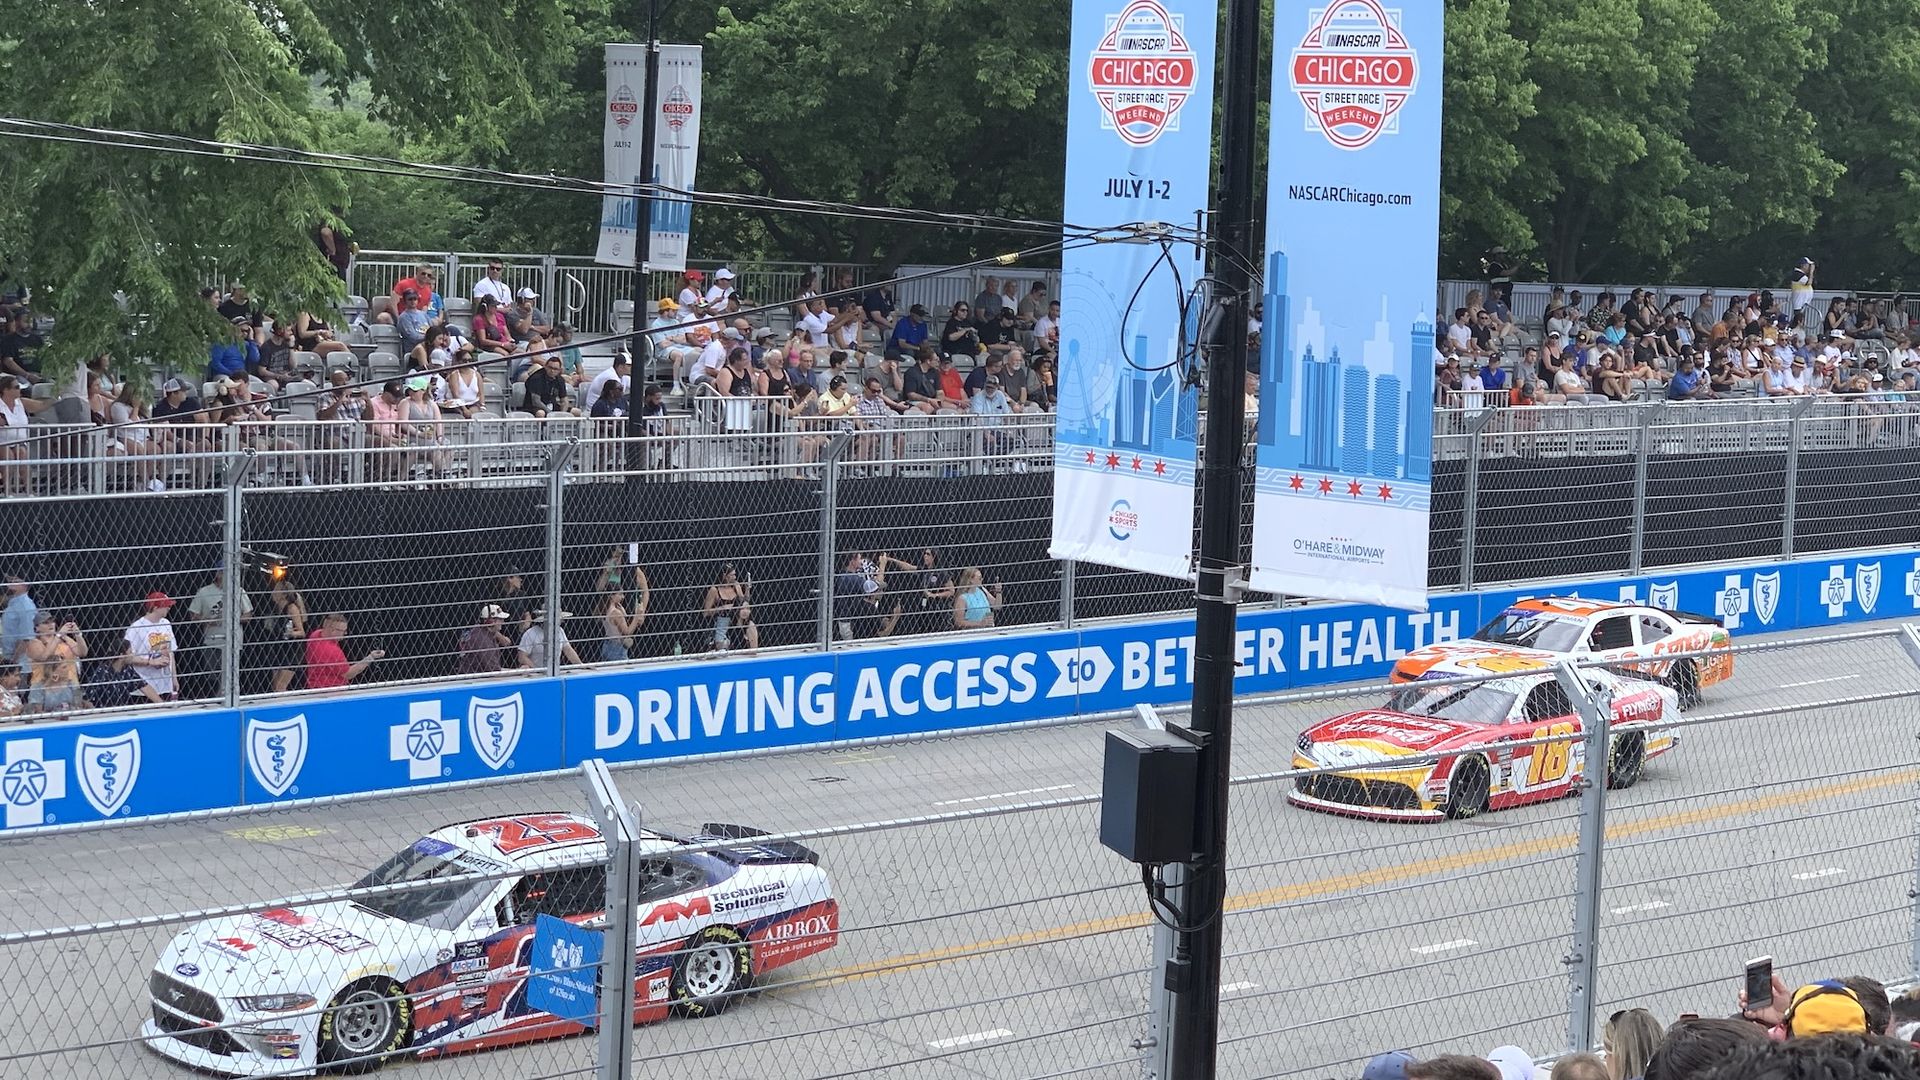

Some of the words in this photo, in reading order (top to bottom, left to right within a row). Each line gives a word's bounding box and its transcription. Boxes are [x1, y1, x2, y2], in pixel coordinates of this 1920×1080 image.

[1129, 38, 1165, 51] NASCAR
[1336, 34, 1381, 48] NASCAR
[1101, 60, 1185, 84] CHICAGO
[1305, 58, 1403, 84] CHICAGO
[1117, 92, 1144, 104] STREET
[1144, 93, 1165, 104] RACE
[1325, 92, 1356, 104] STREET
[1357, 93, 1380, 105] RACE
[1325, 109, 1376, 125] WEEKEND
[1104, 178, 1142, 199] JULY
[1147, 179, 1171, 200] 1-2
[1288, 184, 1412, 207] NASCARChicago.com
[1293, 538, 1332, 553] O'HARE
[1333, 543, 1341, 554] &
[1341, 544, 1385, 559] MIDWAY
[1307, 552, 1346, 562] INTERNATIONAL
[1346, 556, 1370, 564] AIRPORTS
[594, 671, 835, 750] DRIVING
[847, 650, 1038, 722] ACCESS
[1067, 653, 1096, 683] to
[1121, 627, 1288, 692] BETER
[1299, 610, 1460, 671] HEALTH
[1527, 721, 1575, 784] 18
[470, 813, 600, 857] 25
[458, 852, 503, 871] MOFFITT
[712, 880, 786, 903] Technical
[714, 891, 786, 913] Solutions
[761, 914, 832, 948] AIRBOX
